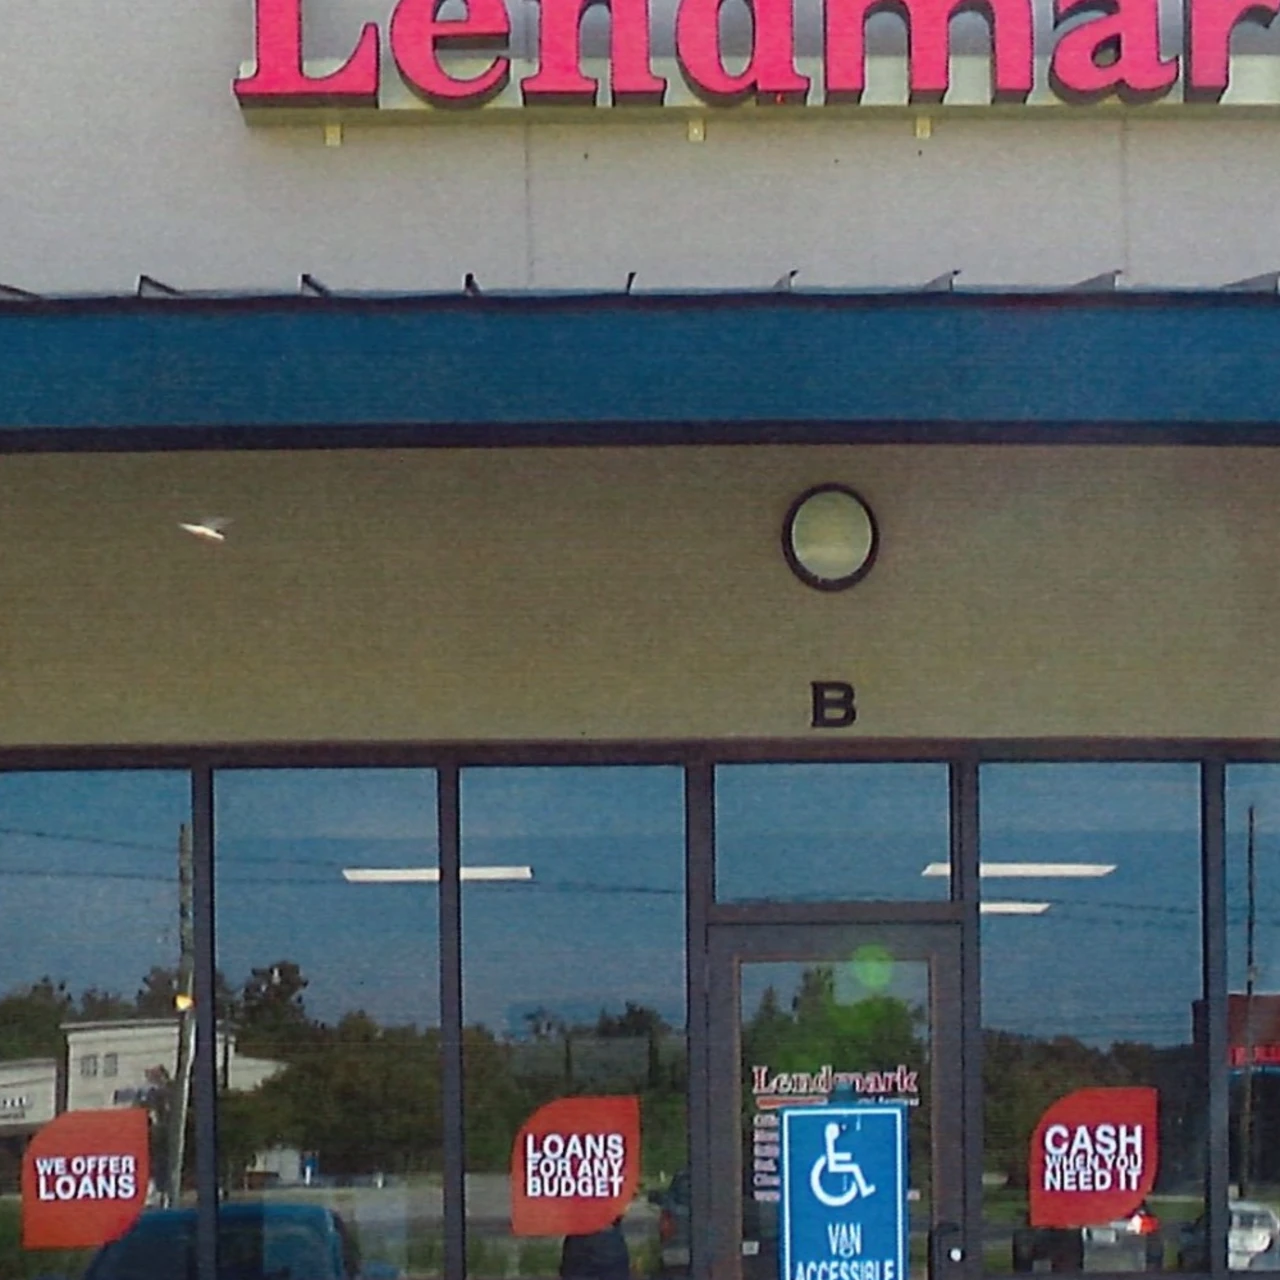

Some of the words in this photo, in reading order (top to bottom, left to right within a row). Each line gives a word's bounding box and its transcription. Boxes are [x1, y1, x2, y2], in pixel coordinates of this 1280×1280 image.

[810, 681, 857, 728] B
[526, 1133, 625, 1160] LOANS
[1044, 1123, 1143, 1155] CASH
[35, 1156, 67, 1176] WE
[70, 1155, 136, 1175] OFFER
[526, 1158, 573, 1178] FOR
[577, 1158, 624, 1178] ANY
[1045, 1153, 1100, 1171] WHEN
[1104, 1153, 1144, 1171] YOU
[38, 1174, 137, 1201] LOANS
[526, 1175, 624, 1198] BUDGET
[1044, 1169, 1113, 1192] NEED
[1118, 1169, 1141, 1192] IT
[827, 1223, 862, 1256] VAN
